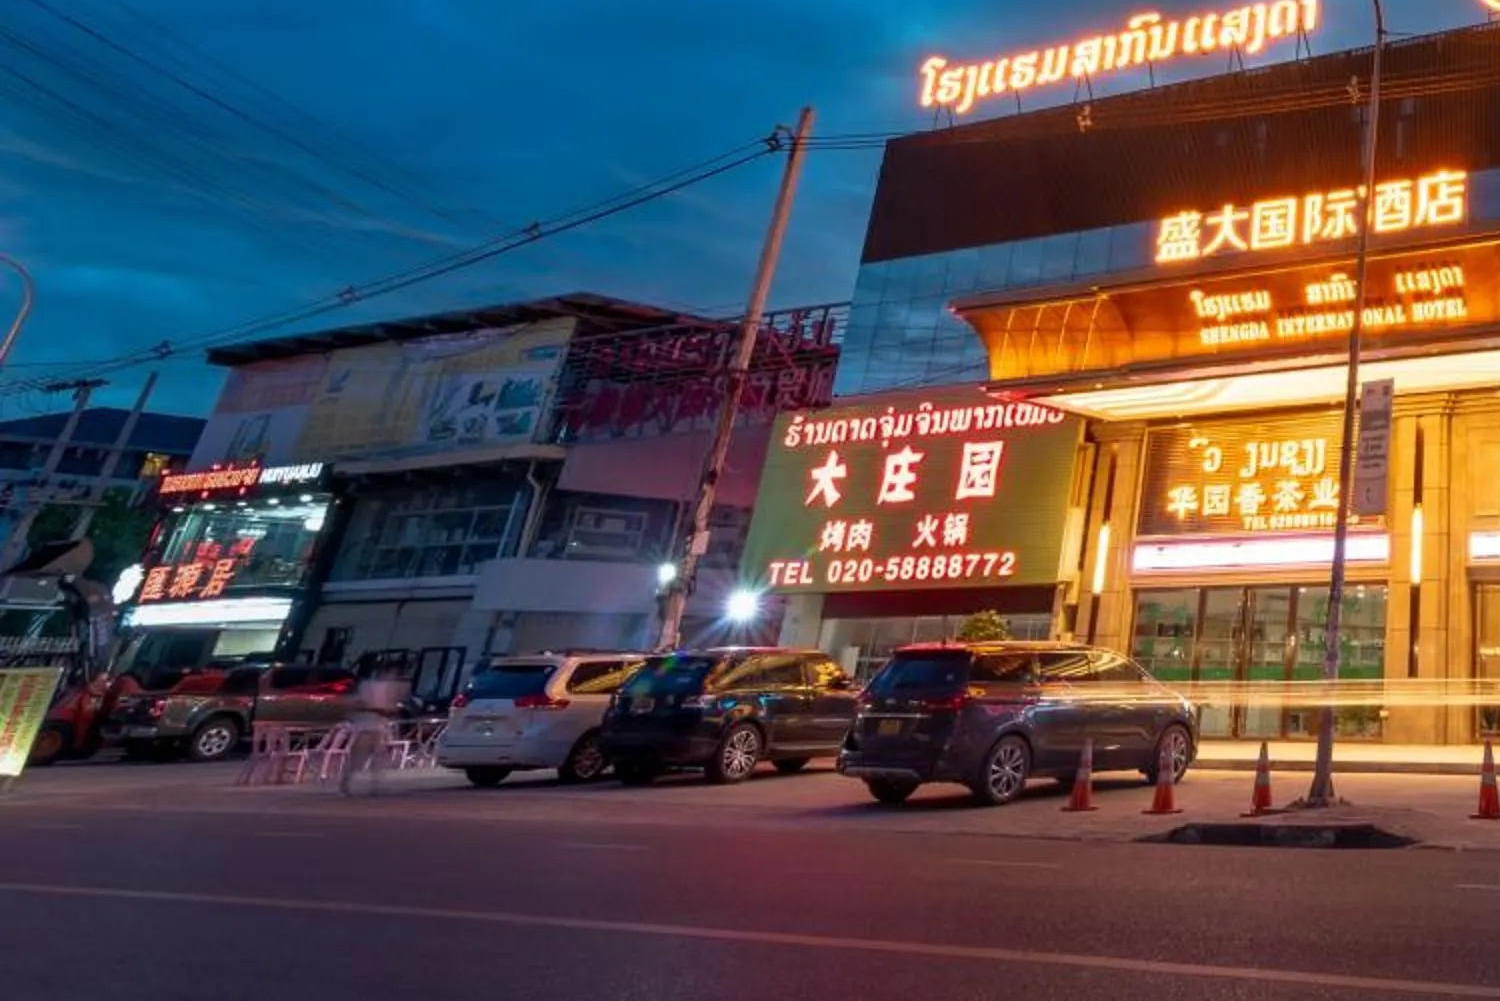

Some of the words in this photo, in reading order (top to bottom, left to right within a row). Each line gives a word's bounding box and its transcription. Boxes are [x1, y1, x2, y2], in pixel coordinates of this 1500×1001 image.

[1155, 170, 1466, 263] 盛大国际酒店
[1201, 322, 1270, 345] SHENGDA
[1276, 305, 1406, 337] INTERNATONAL
[1411, 297, 1467, 322] HOTEL
[819, 518, 873, 551] 烤肉
[911, 512, 969, 548] 火锅
[769, 561, 814, 585] TEL
[827, 552, 1016, 584] 020-58888772
